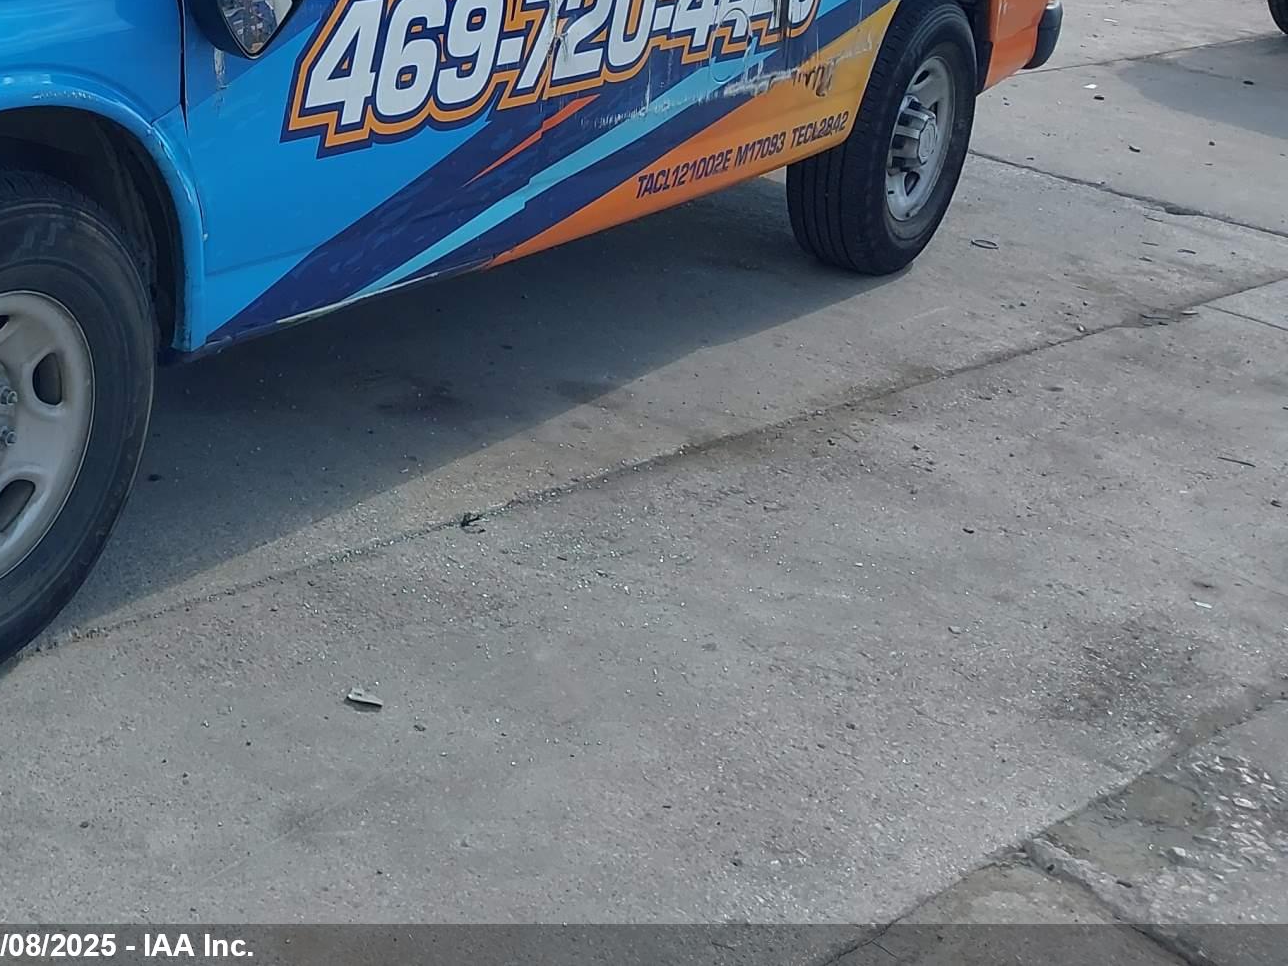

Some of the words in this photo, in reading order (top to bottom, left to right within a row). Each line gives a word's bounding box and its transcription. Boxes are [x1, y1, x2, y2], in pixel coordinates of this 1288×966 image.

[635, 147, 734, 200] TACL121002E
[734, 132, 788, 168] M17093
[789, 110, 850, 151] TECL2842
